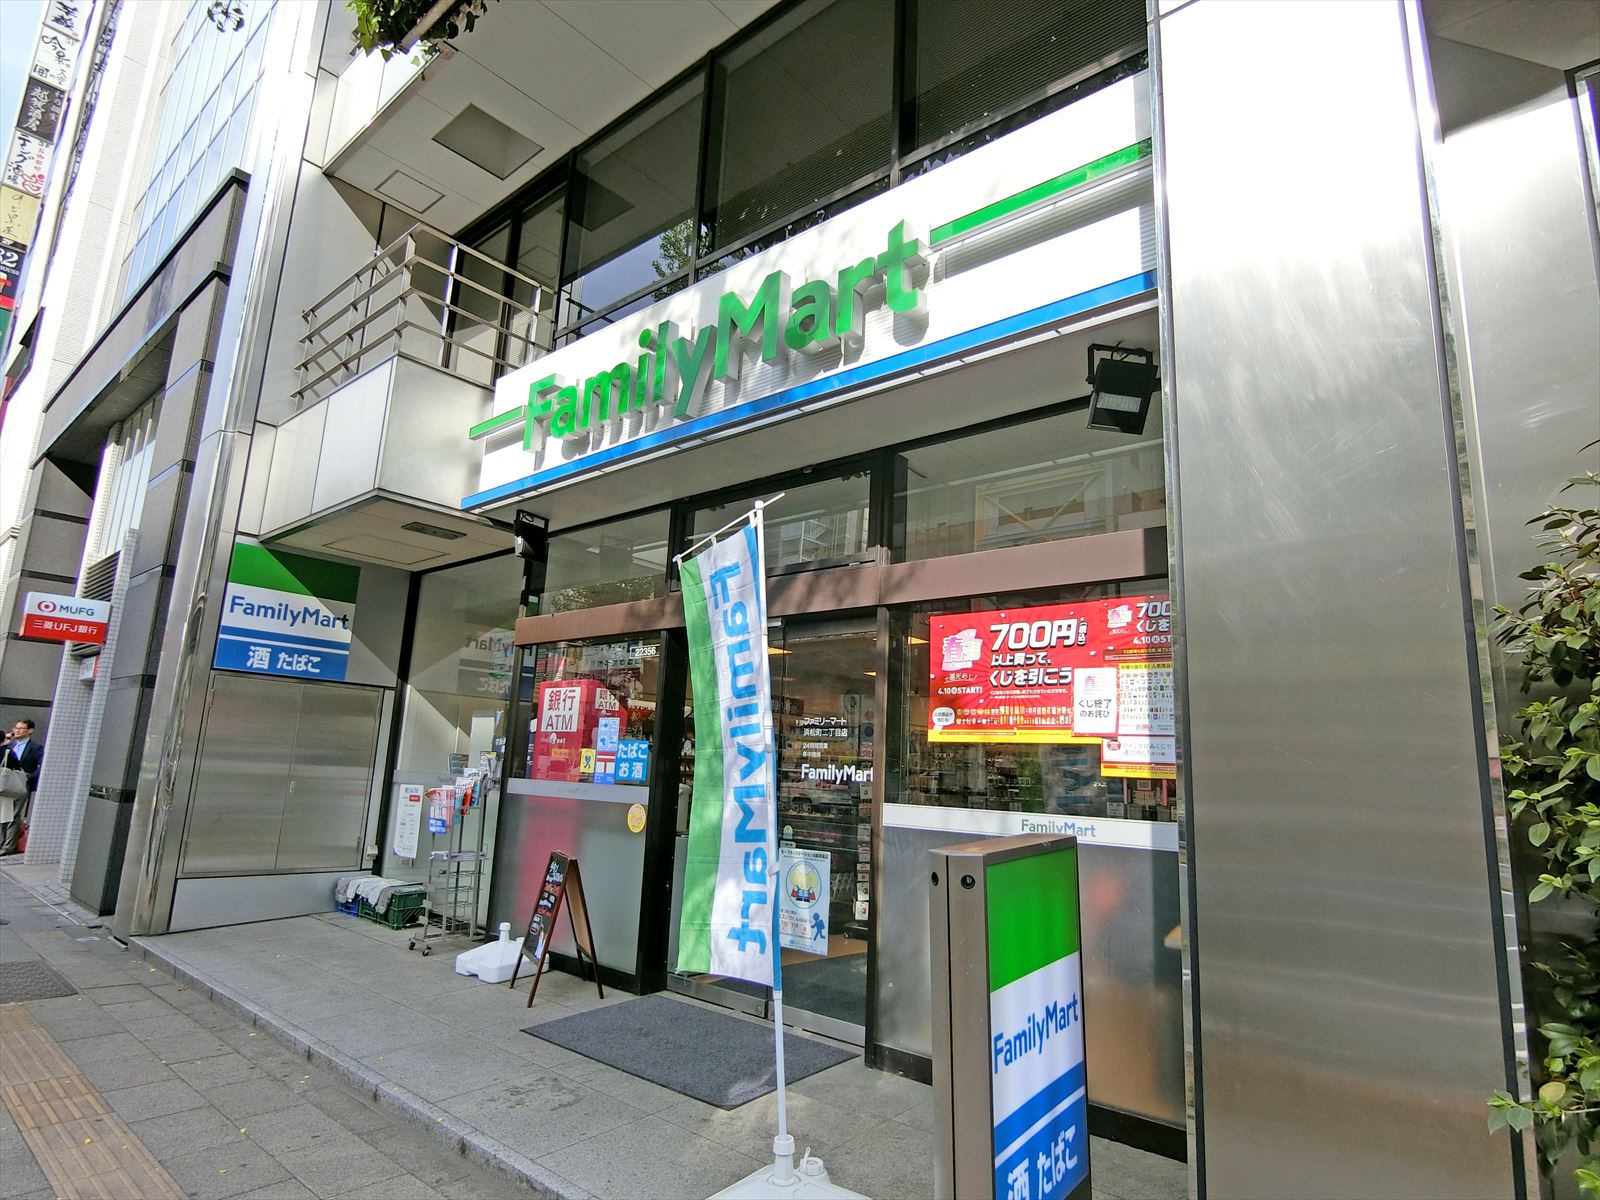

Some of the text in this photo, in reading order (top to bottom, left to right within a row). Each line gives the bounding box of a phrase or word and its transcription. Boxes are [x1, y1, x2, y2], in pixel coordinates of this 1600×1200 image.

[522, 219, 924, 451] FamilyMart
[59, 604, 95, 616] MUFG
[229, 595, 349, 630] FamilyMart
[33, 619, 98, 635] 三菱UFJ銀行
[1136, 619, 1170, 632] くじを
[246, 645, 321, 673] 酒 たばこ
[635, 646, 656, 656] 22356
[989, 667, 1072, 686] くじを引こう
[548, 689, 576, 711] 銀行
[598, 701, 617, 710] ATM
[1078, 698, 1112, 708] くじ終了
[545, 714, 573, 730] ATM
[803, 716, 847, 726] ファミリーマート
[617, 743, 648, 758] たばこ
[618, 761, 643, 779] お酒
[994, 992, 1079, 1074] FamilyMart
[1037, 1124, 1078, 1200] たばこ
